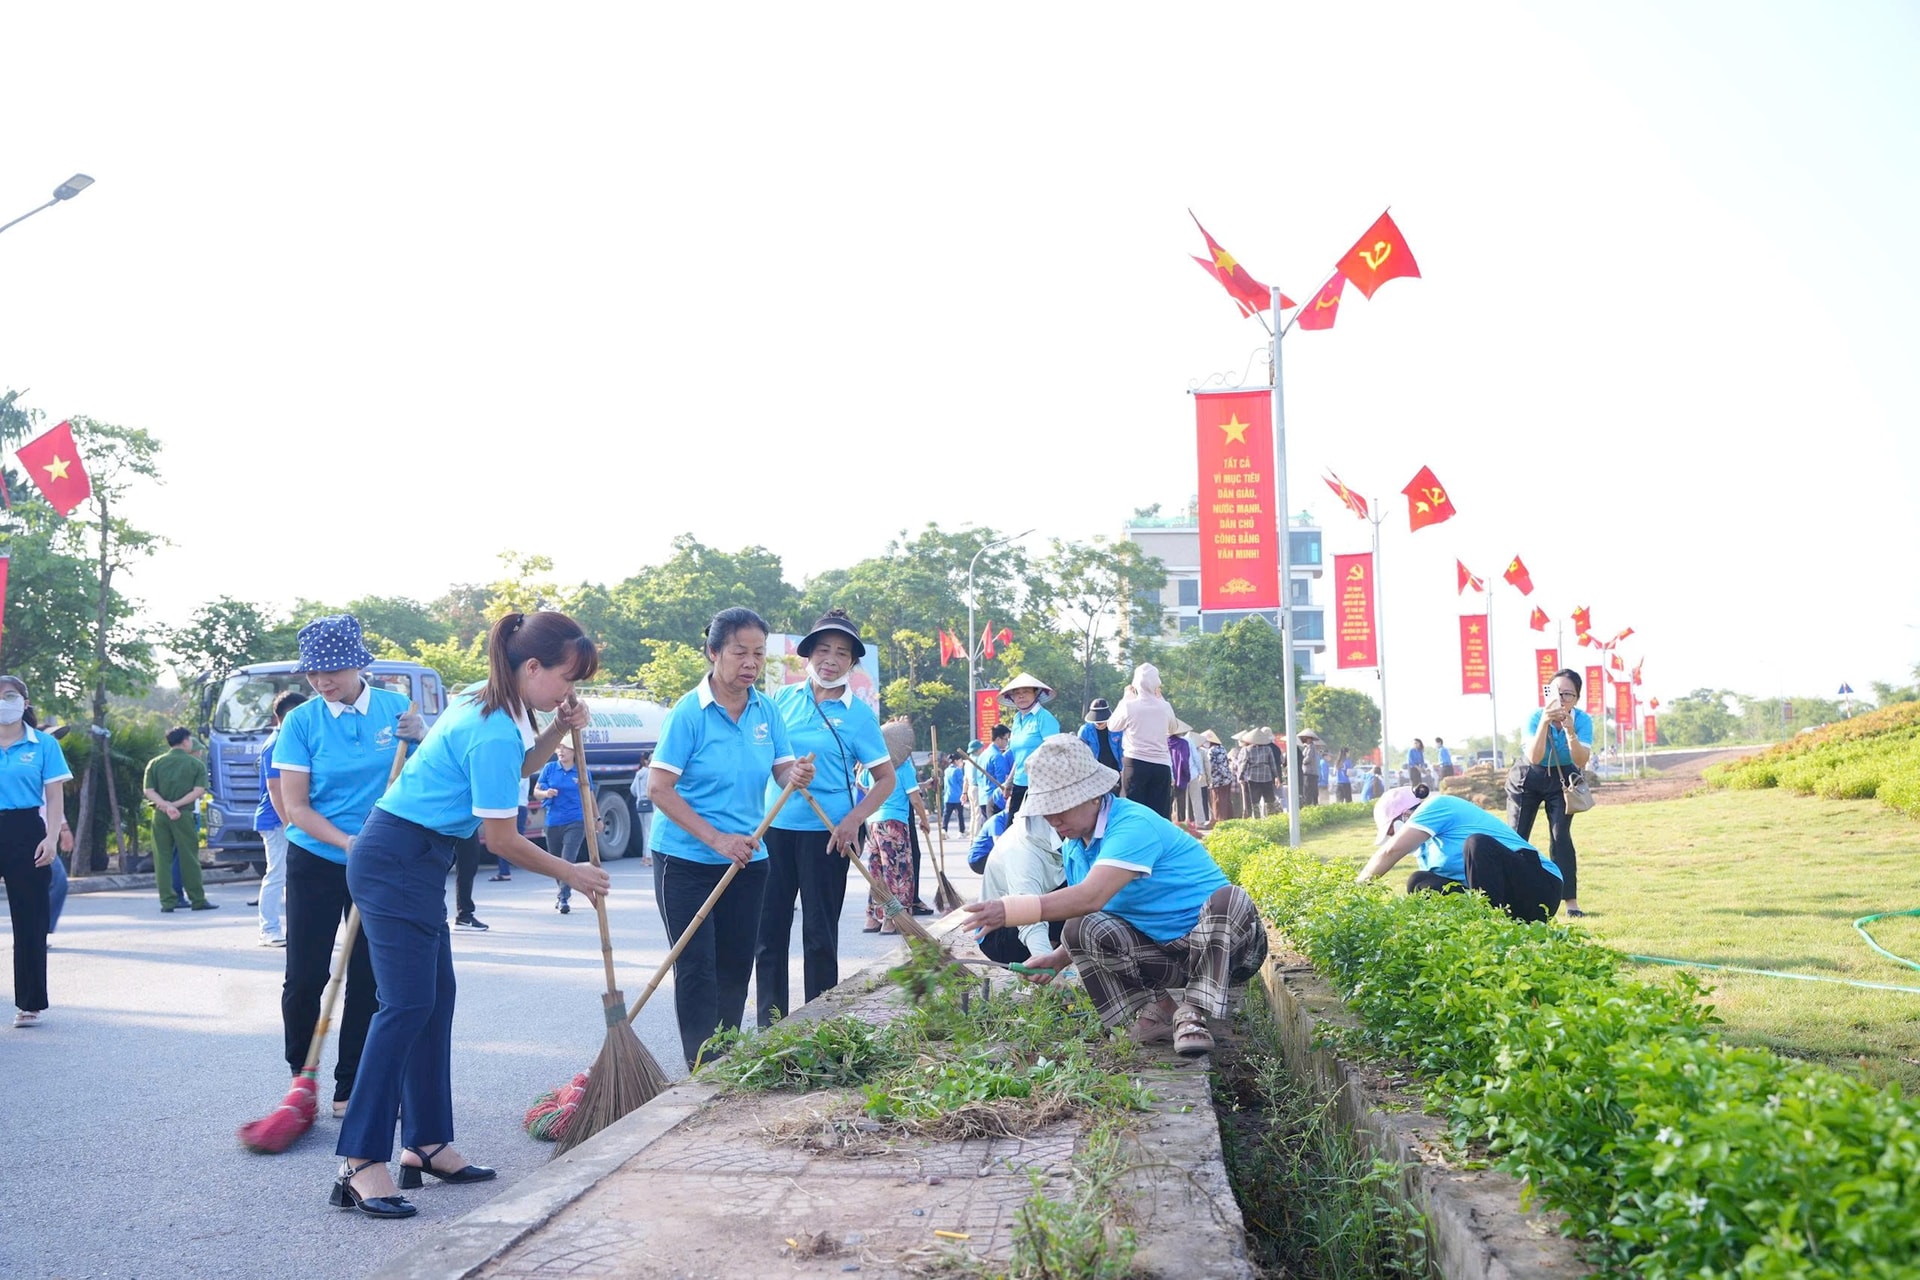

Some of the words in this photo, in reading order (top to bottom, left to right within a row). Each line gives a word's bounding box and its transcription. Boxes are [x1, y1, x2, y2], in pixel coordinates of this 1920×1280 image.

[1224, 456, 1237, 468] TẤT
[1224, 474, 1242, 486] MỤC
[1244, 472, 1260, 483] TIÊU
[1218, 488, 1234, 498] DÂN
[1213, 503, 1234, 514] NƯỚC
[1220, 518, 1236, 529] DÂN
[1214, 533, 1236, 544] CÔNG
